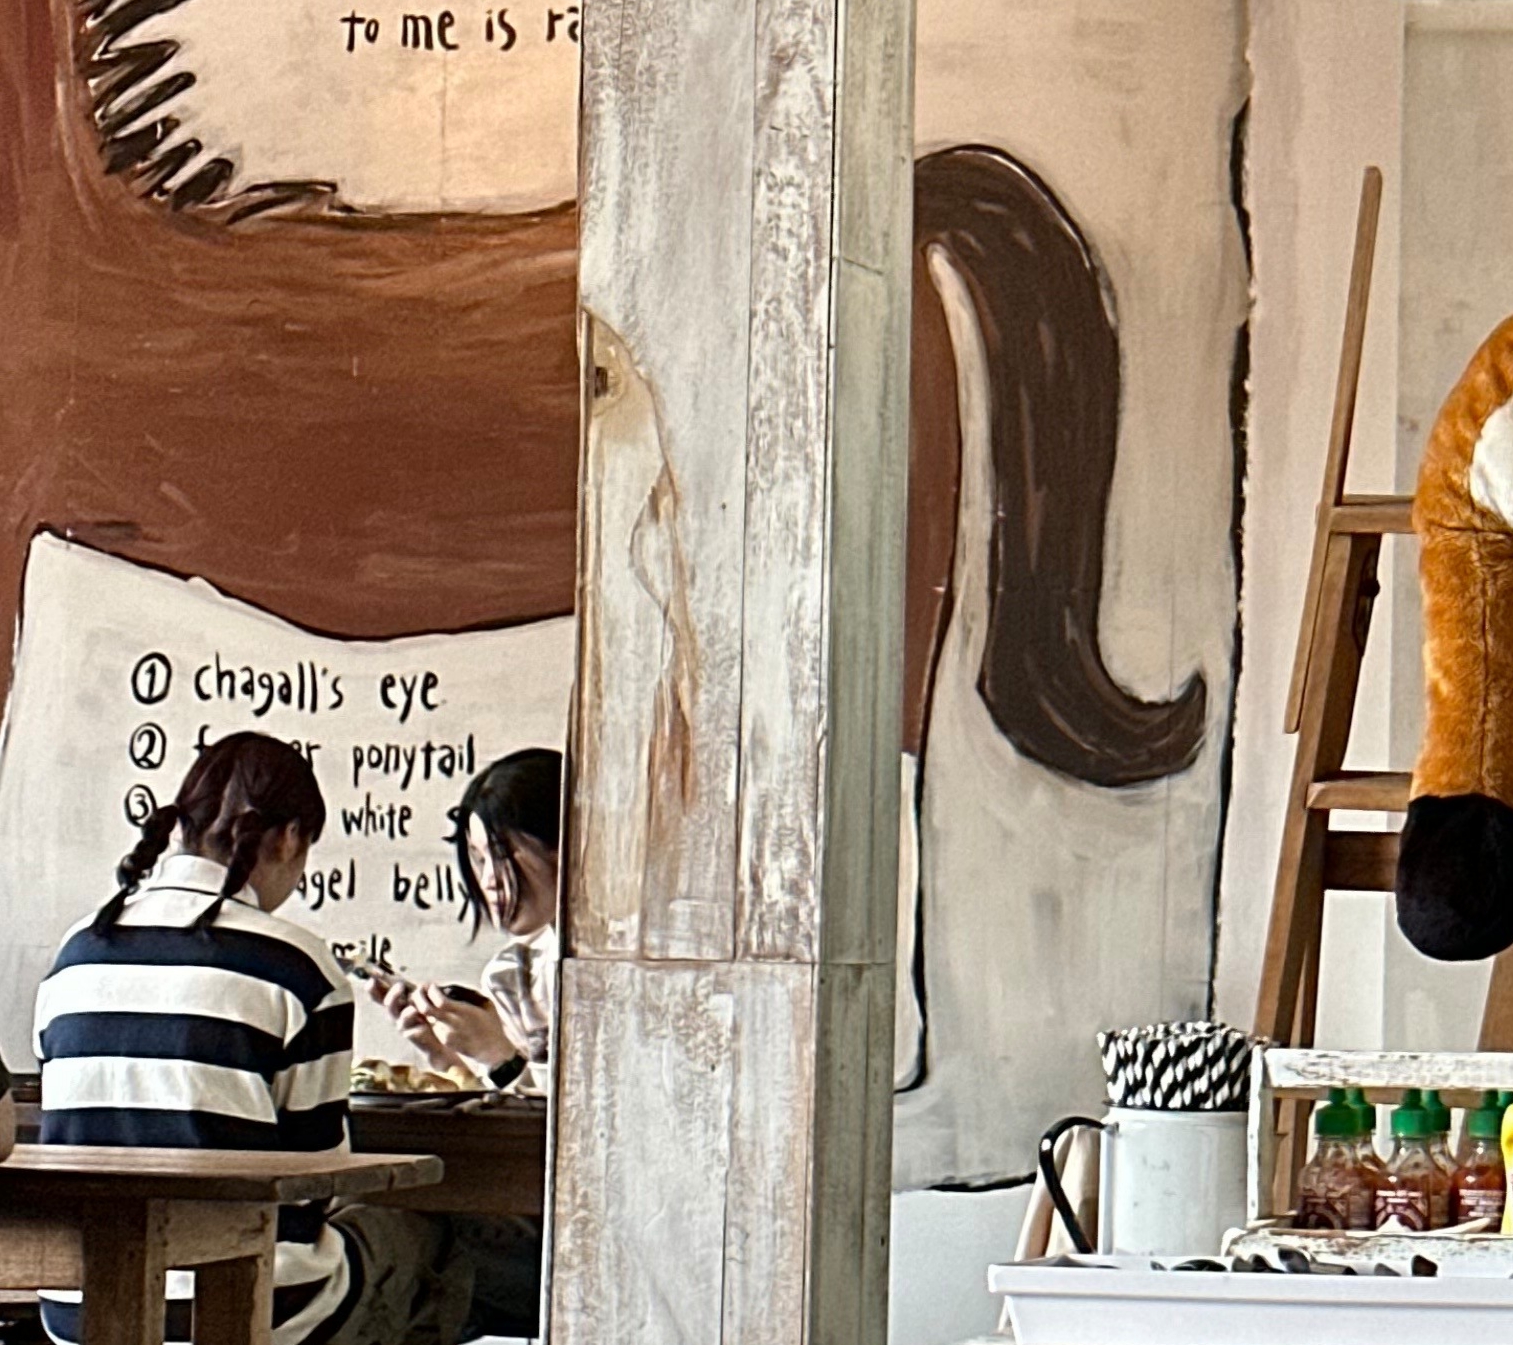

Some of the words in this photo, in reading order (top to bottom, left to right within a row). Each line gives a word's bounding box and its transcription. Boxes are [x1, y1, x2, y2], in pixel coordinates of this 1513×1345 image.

[341, 11, 380, 52] to
[401, 10, 460, 51] me
[486, 8, 517, 52] is
[380, 671, 439, 723] eye
[353, 733, 476, 790] ponytail
[341, 791, 412, 840] white
